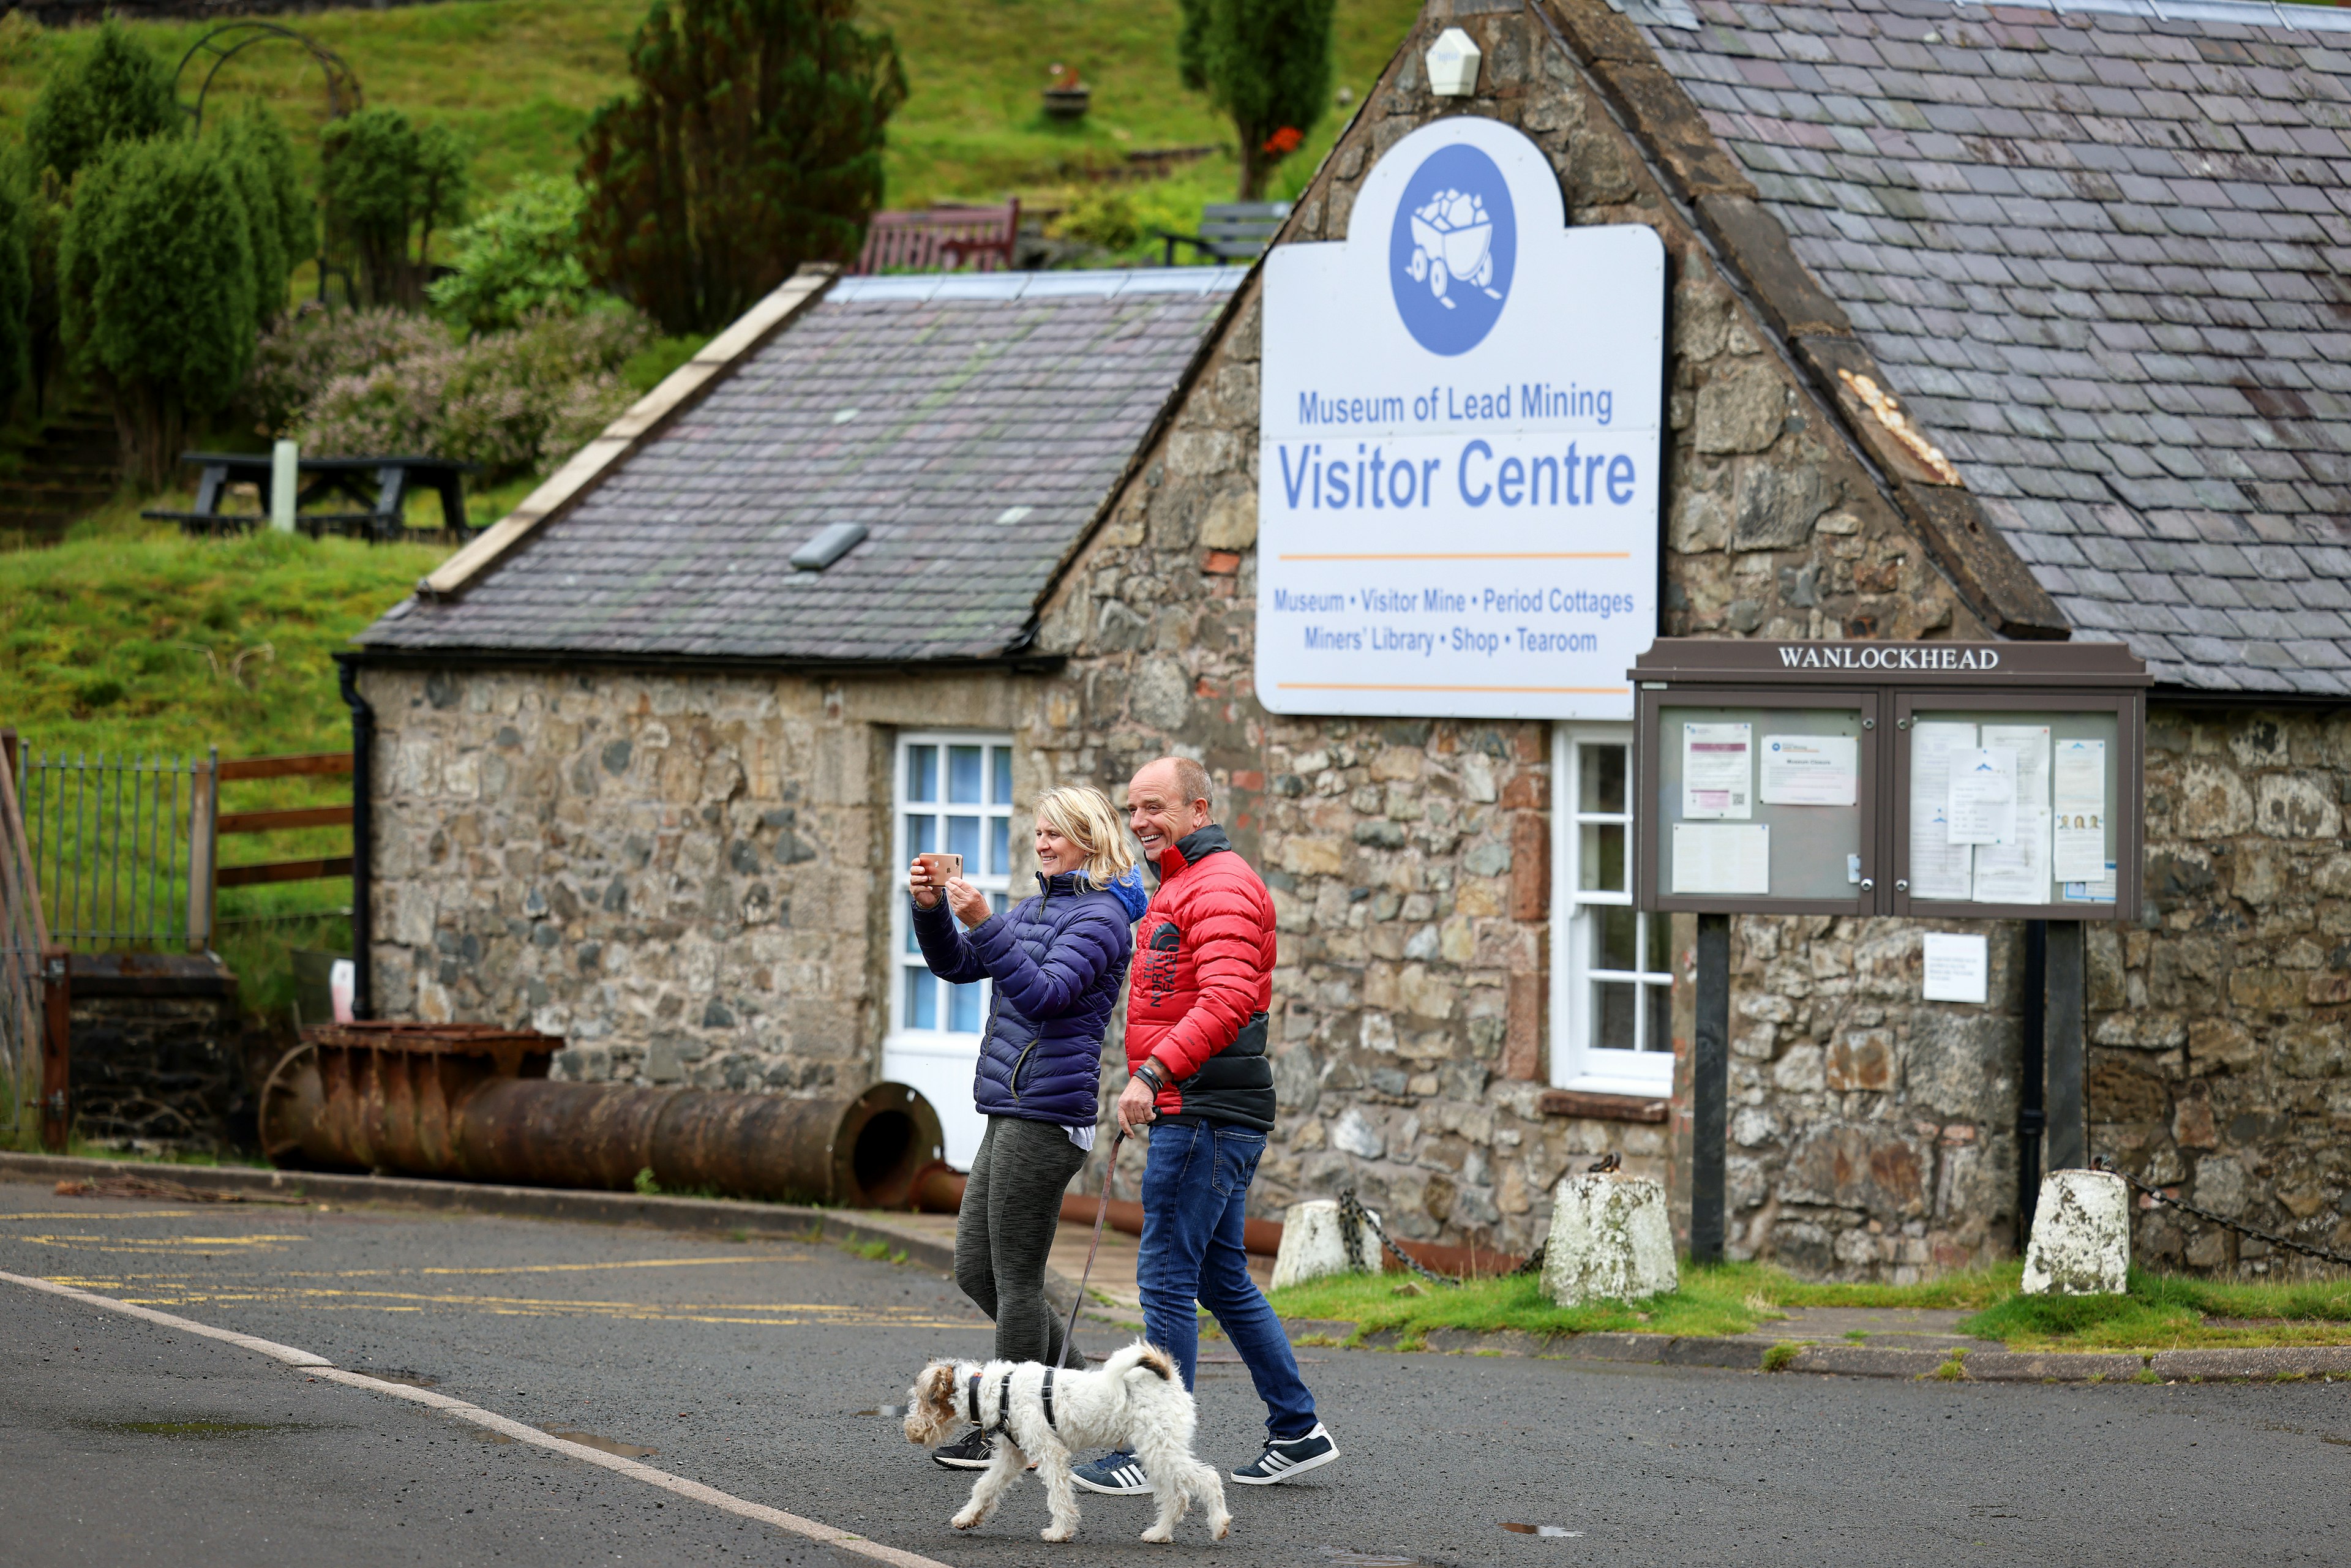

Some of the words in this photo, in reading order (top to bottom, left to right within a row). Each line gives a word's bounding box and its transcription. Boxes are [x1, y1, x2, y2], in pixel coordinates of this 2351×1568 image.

[1299, 391, 1404, 425] Museum
[1413, 386, 1441, 422] of
[1448, 384, 1512, 421] Lead
[1521, 381, 1613, 427] Mining
[1278, 442, 1442, 510] Visitor
[1457, 438, 1637, 508] Centre
[1274, 588, 1345, 612] Museum
[1360, 588, 1419, 612] Visitor
[1423, 588, 1466, 613] Mine
[1483, 587, 1543, 613] Period
[1548, 587, 1635, 620] Cottages
[1371, 626, 1434, 657] Library
[1451, 626, 1499, 658] Shop
[1517, 626, 1598, 653] Tearoom
[1778, 646, 1999, 670] WANLOCKHEAD
[1144, 950, 1153, 981] THE
[1150, 951, 1165, 1008] NORTH
[1163, 951, 1178, 992] FACE
